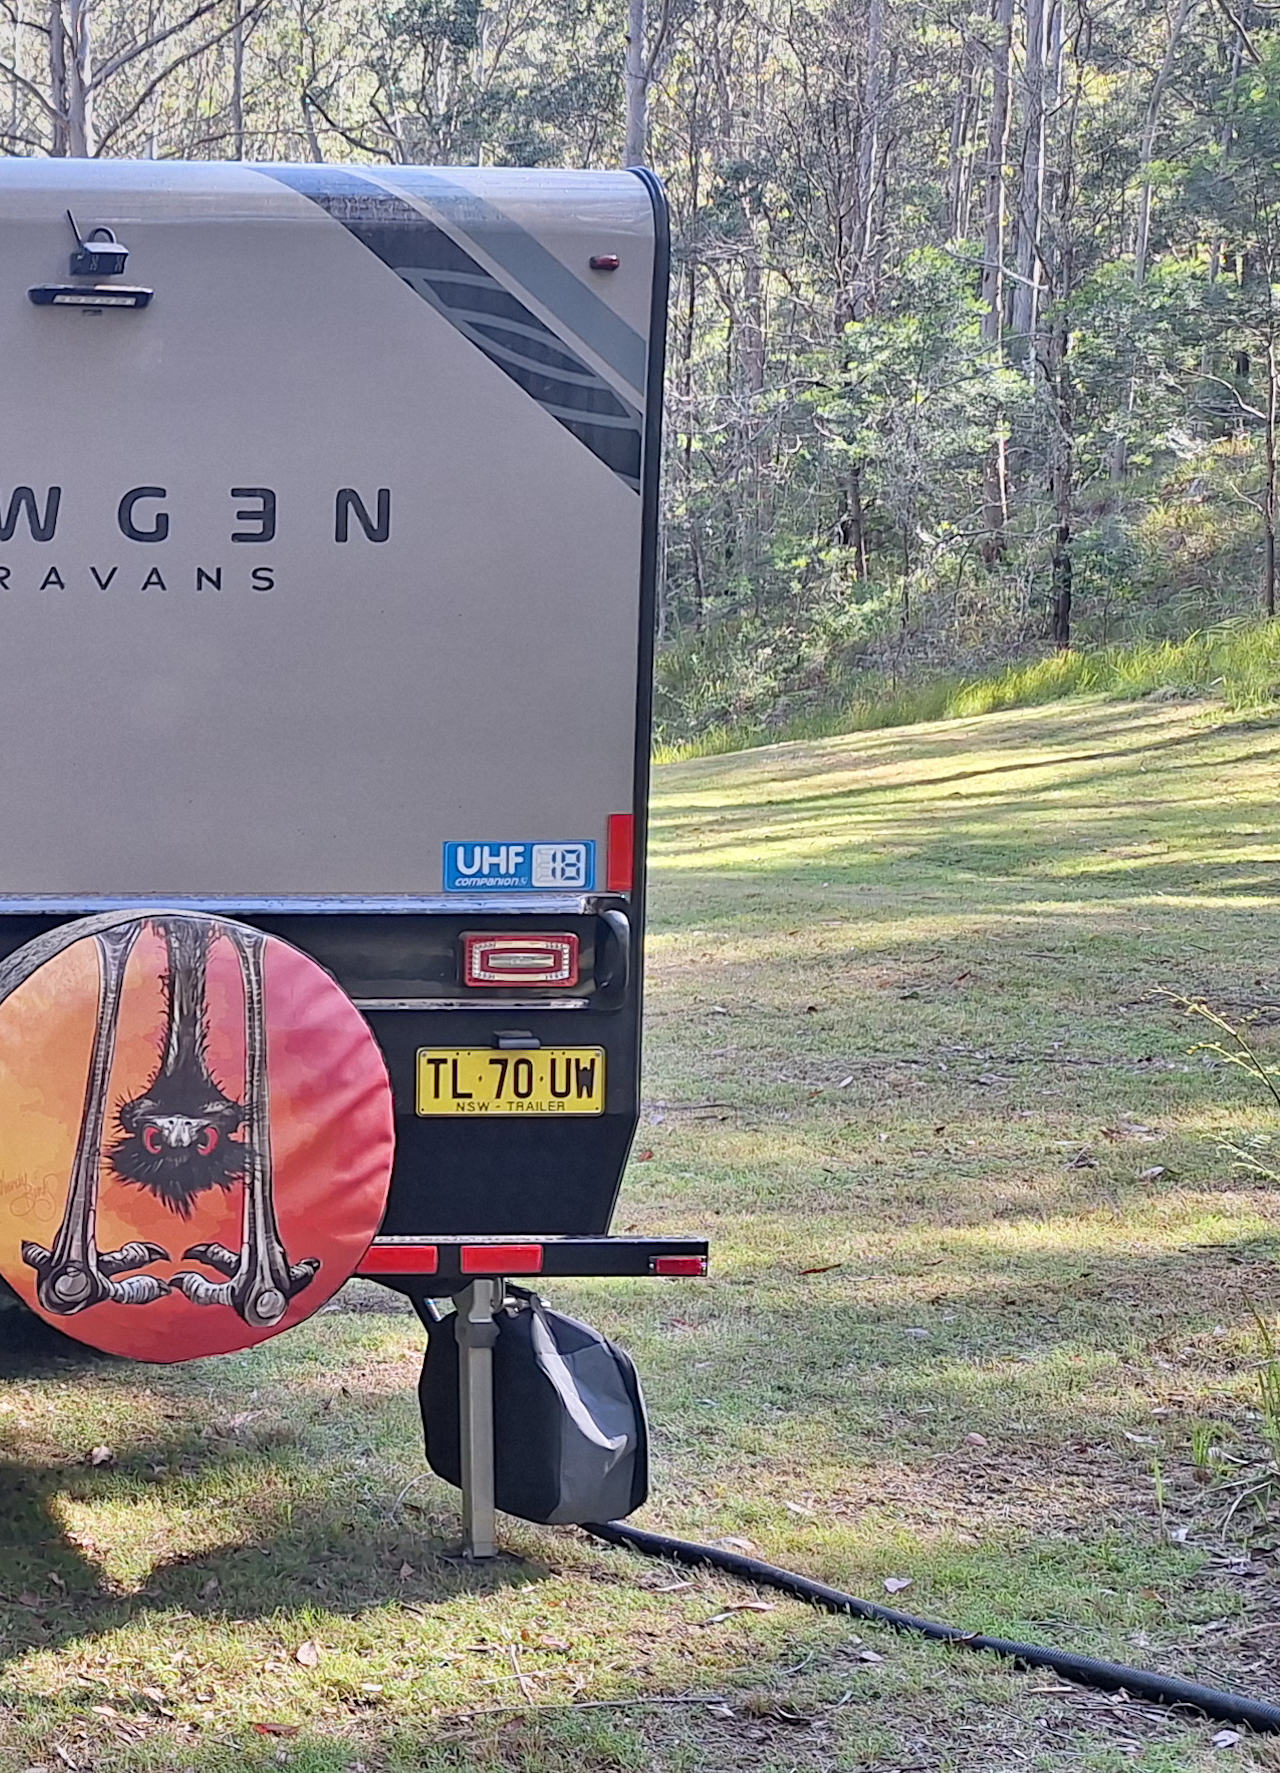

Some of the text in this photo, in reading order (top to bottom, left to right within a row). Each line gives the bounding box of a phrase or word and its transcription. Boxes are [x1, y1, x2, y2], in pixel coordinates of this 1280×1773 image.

[456, 845, 581, 881] UHF 18
[454, 877, 519, 887] companion
[426, 1057, 596, 1099] TL 70 UW
[456, 1101, 490, 1112] NSW
[507, 1101, 566, 1112] TRAILER
